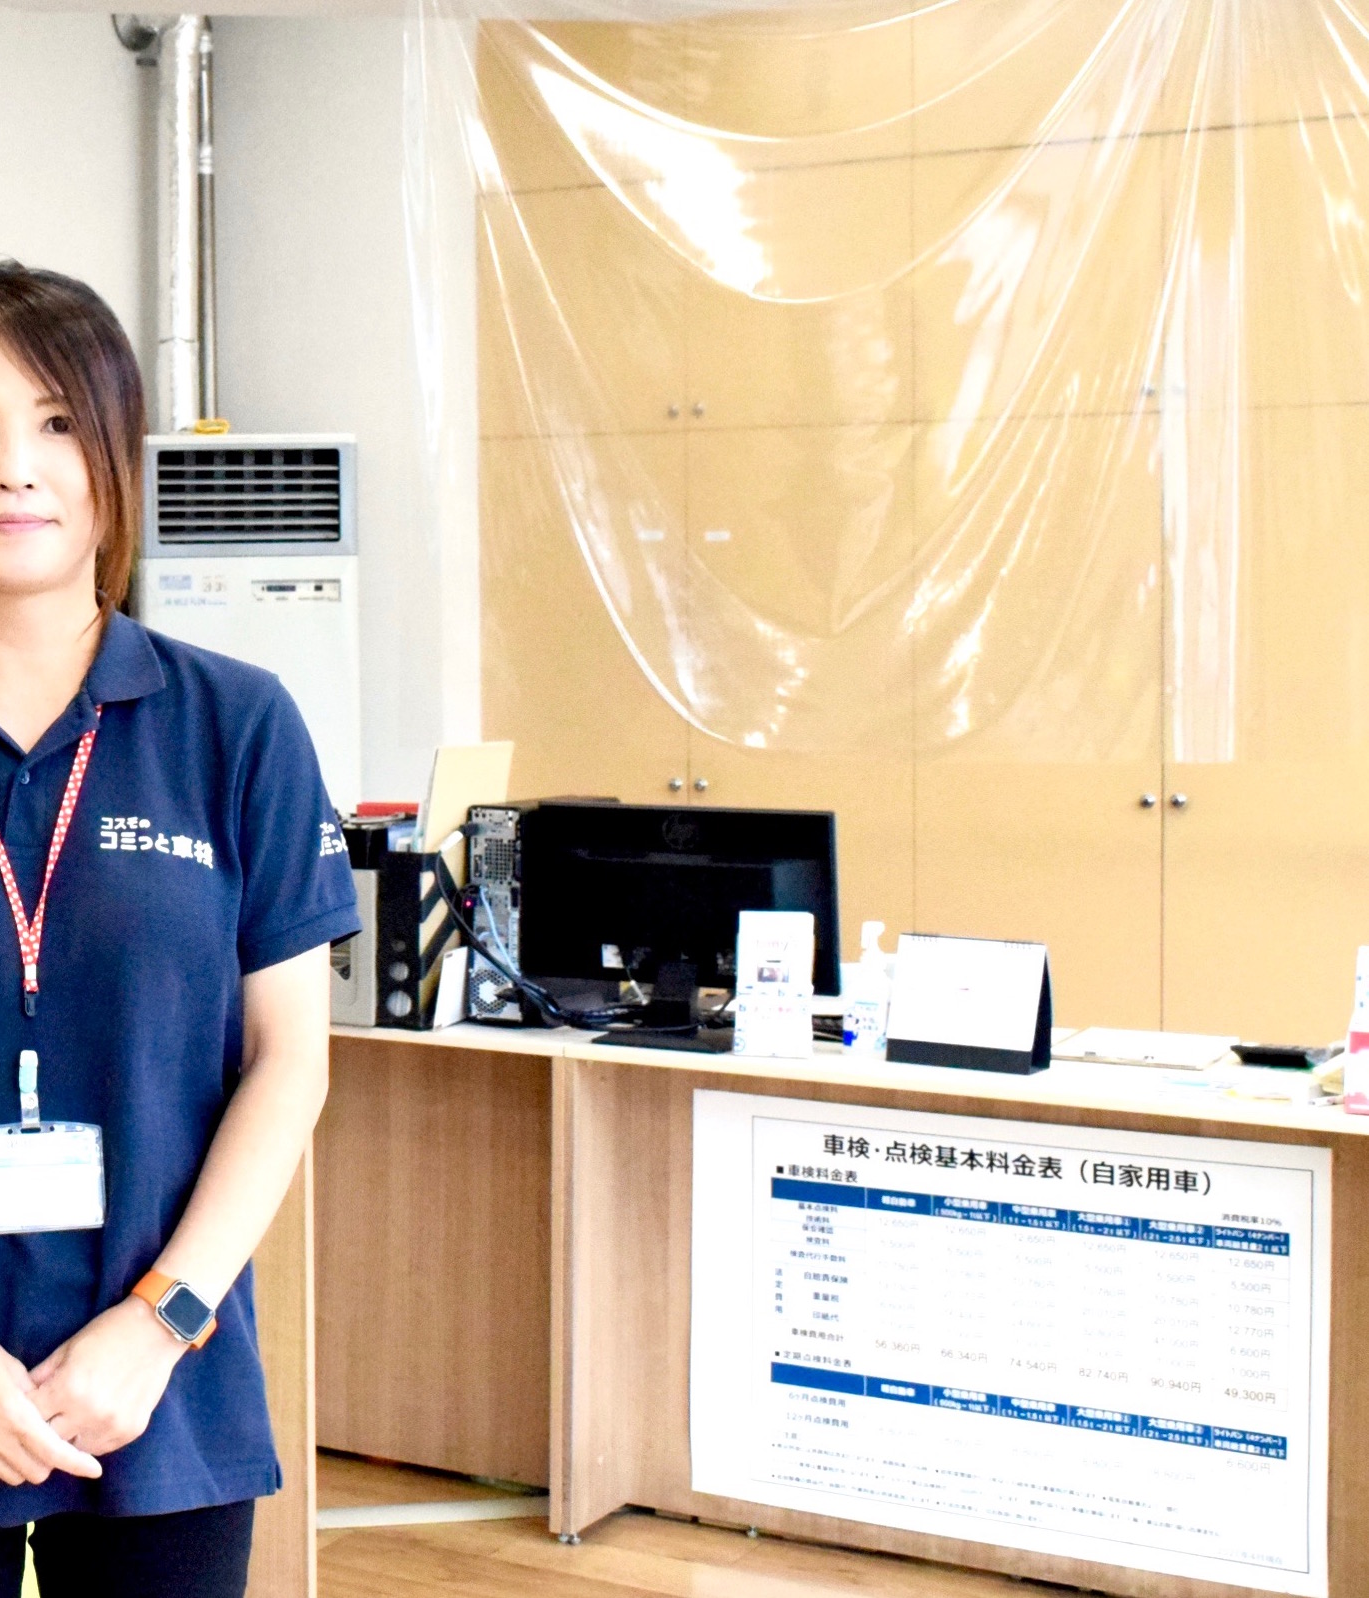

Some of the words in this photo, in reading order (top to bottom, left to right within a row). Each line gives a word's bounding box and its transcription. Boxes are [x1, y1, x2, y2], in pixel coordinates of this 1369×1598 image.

[100, 816, 151, 830] コスモの
[787, 1164, 859, 1184] 車検料金表
[1221, 1212, 1284, 1228] 消費税率10%
[782, 1350, 853, 1369] 定期点検料金表
